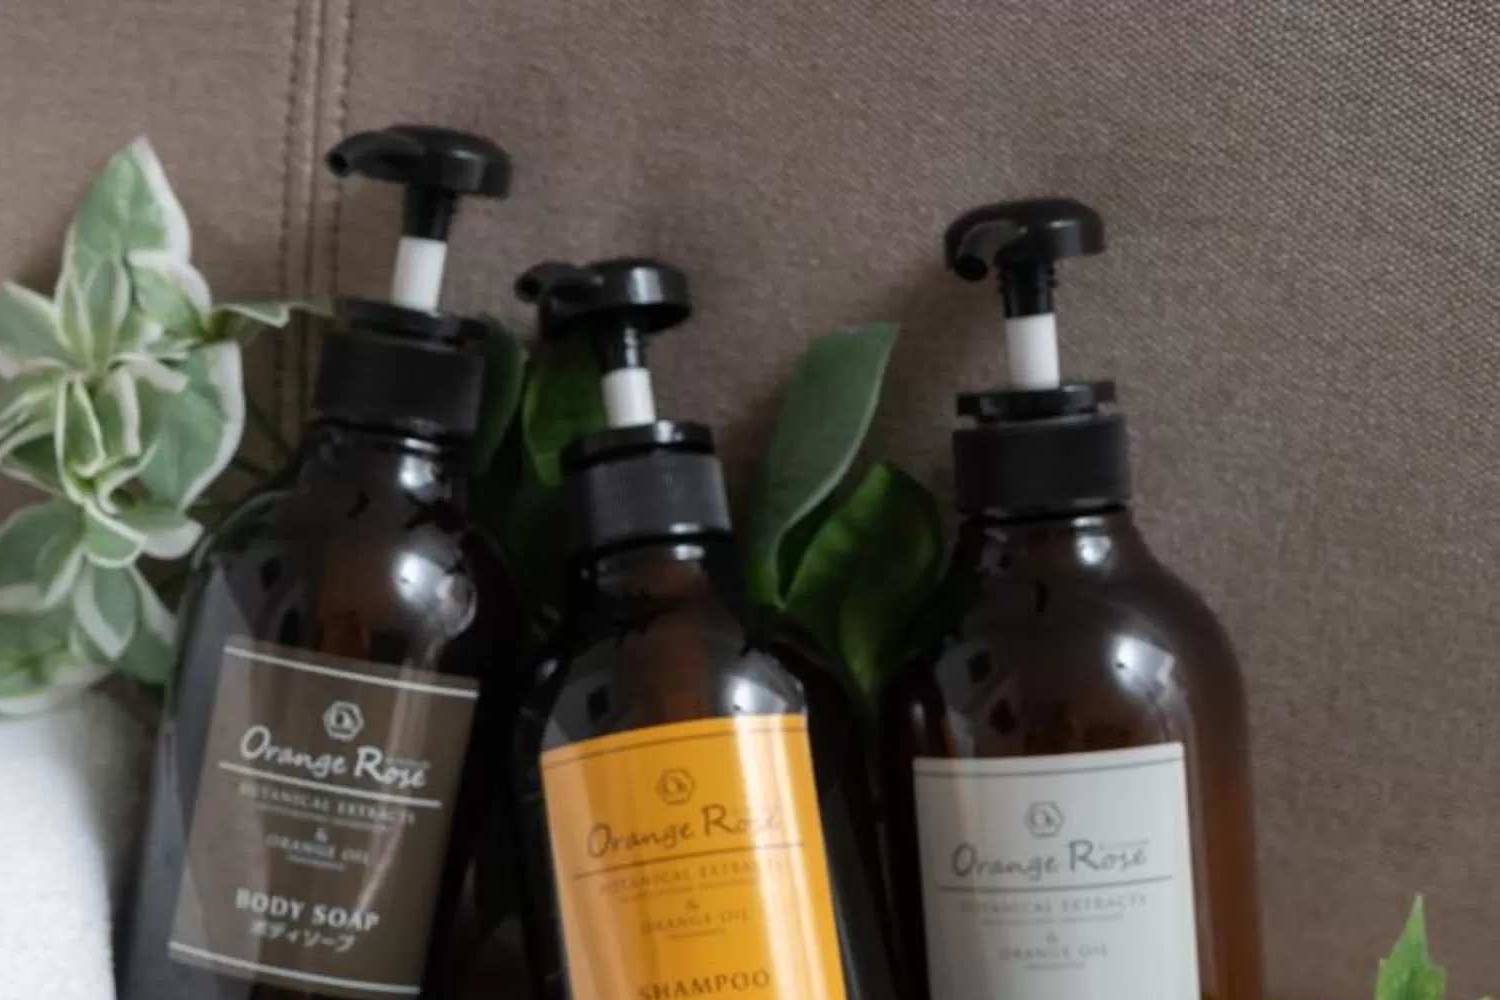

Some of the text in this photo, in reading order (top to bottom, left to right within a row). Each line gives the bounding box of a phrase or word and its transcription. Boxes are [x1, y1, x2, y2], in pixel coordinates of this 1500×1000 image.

[239, 725, 426, 789] Orange Rose
[587, 824, 694, 858] Orange
[952, 839, 1148, 881] Orange Rose
[235, 888, 379, 932] BODY SOAP
[251, 918, 356, 951] ボディソープ
